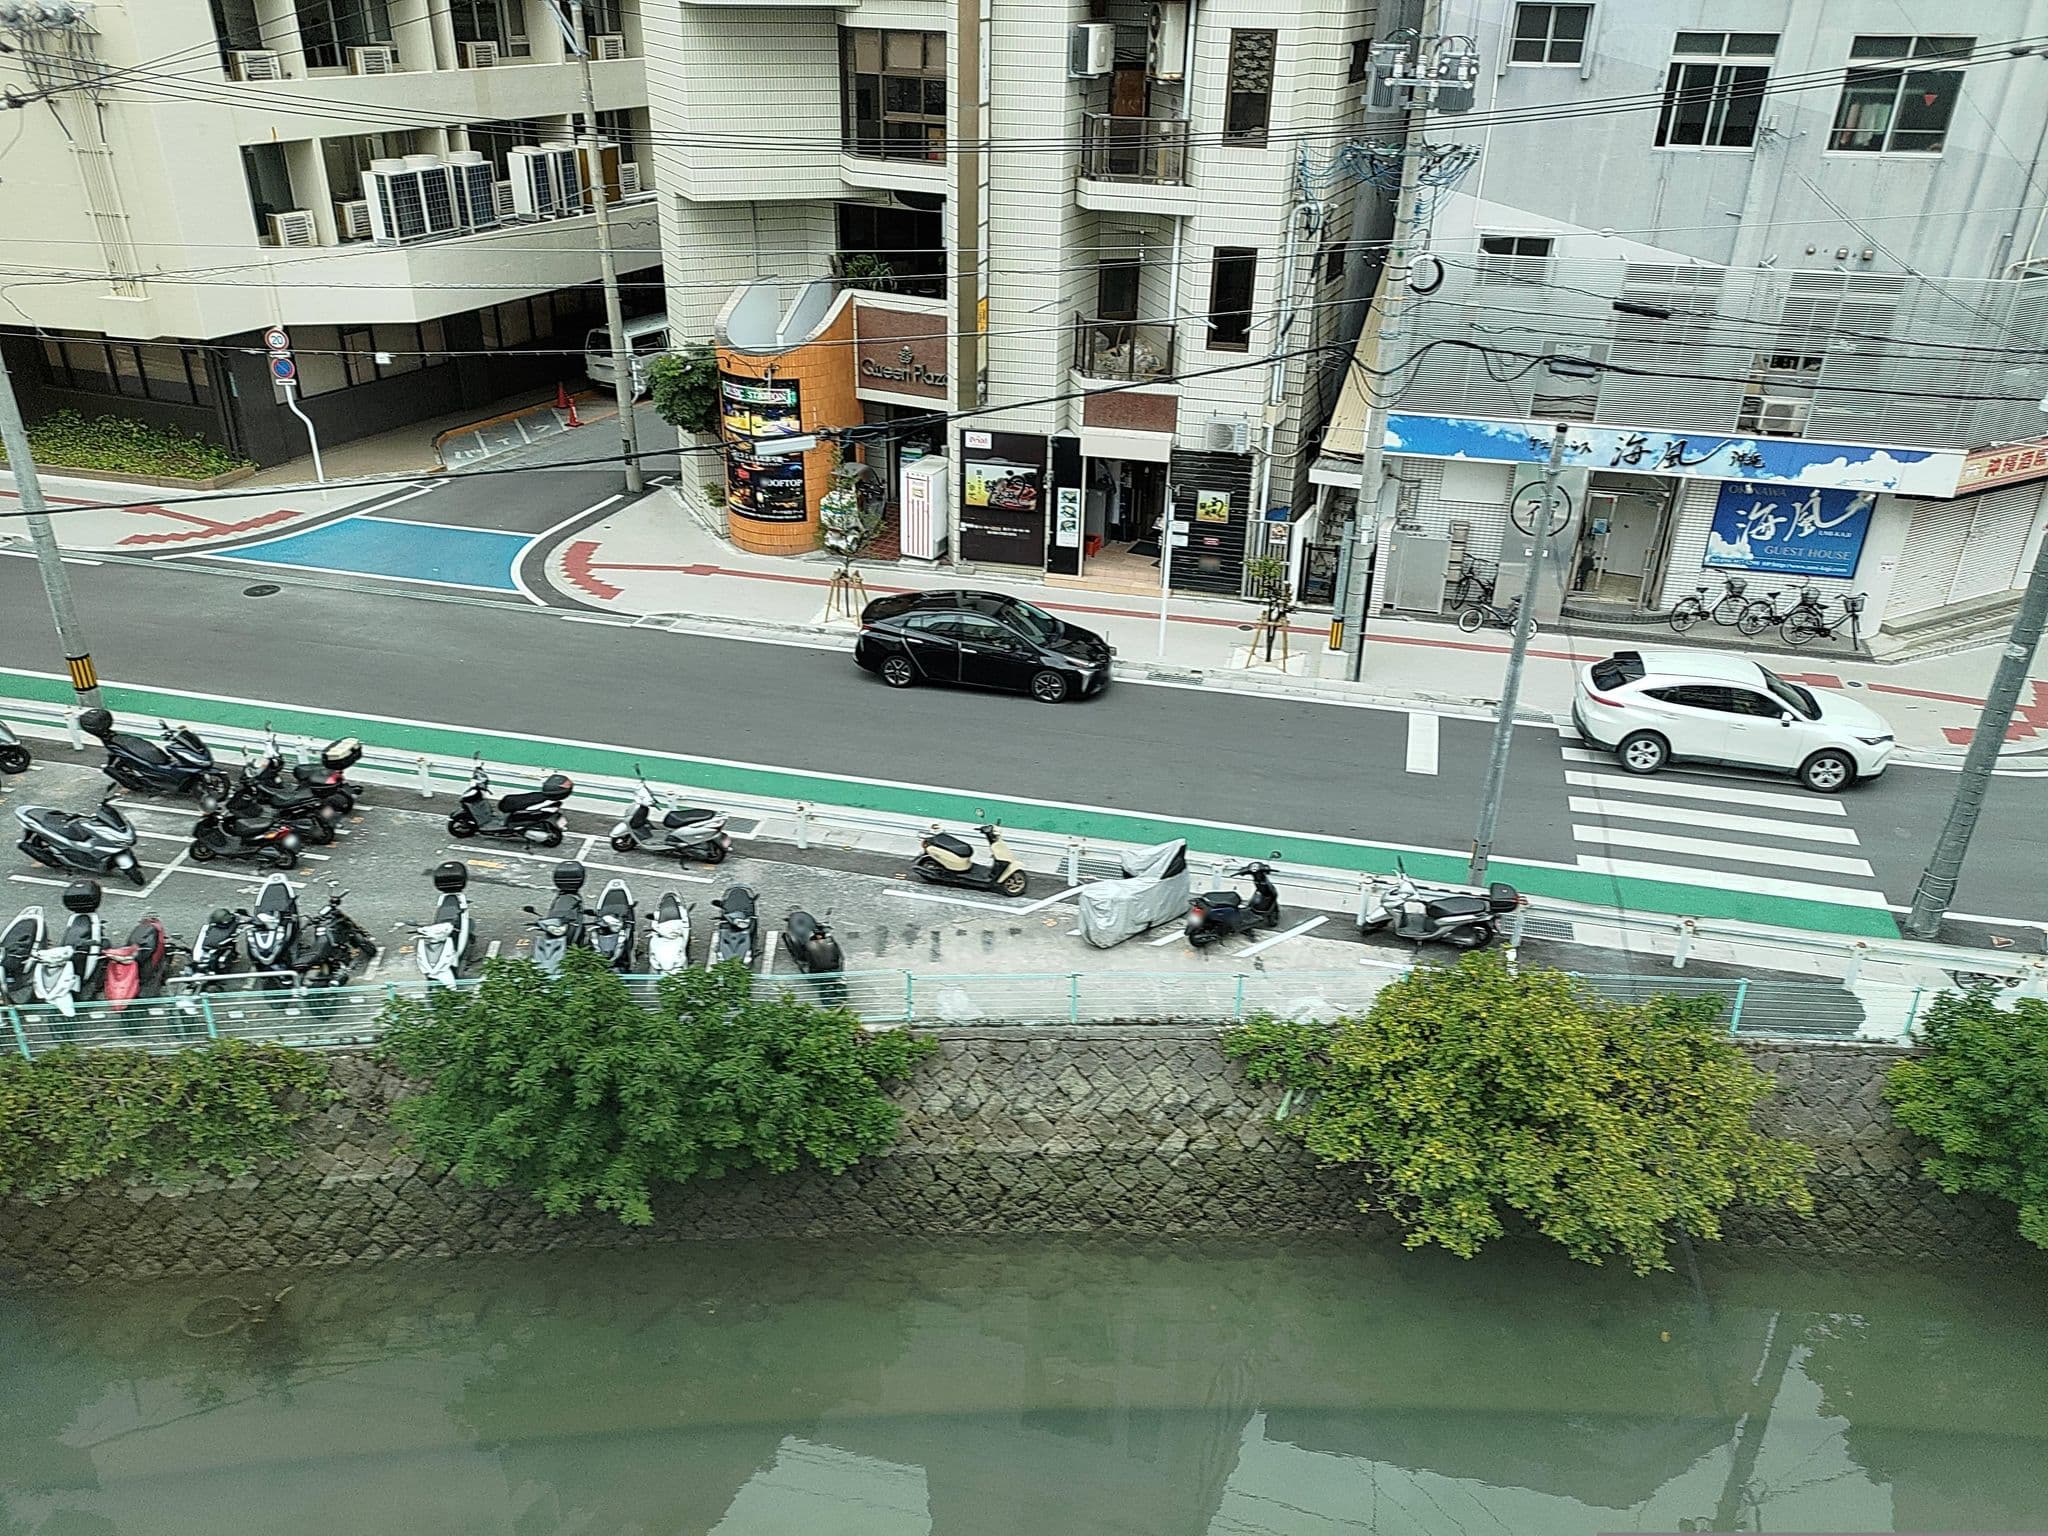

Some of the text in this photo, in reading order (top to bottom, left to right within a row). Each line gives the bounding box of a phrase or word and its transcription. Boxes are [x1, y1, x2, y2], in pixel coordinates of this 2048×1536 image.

[271, 335, 284, 345] 20
[862, 357, 911, 384] Queen
[1610, 432, 1731, 470] 海風
[1728, 484, 1788, 497] OKNAWA
[1735, 488, 1877, 543] 海風
[1764, 545, 1852, 561] GUEST HOUSE
